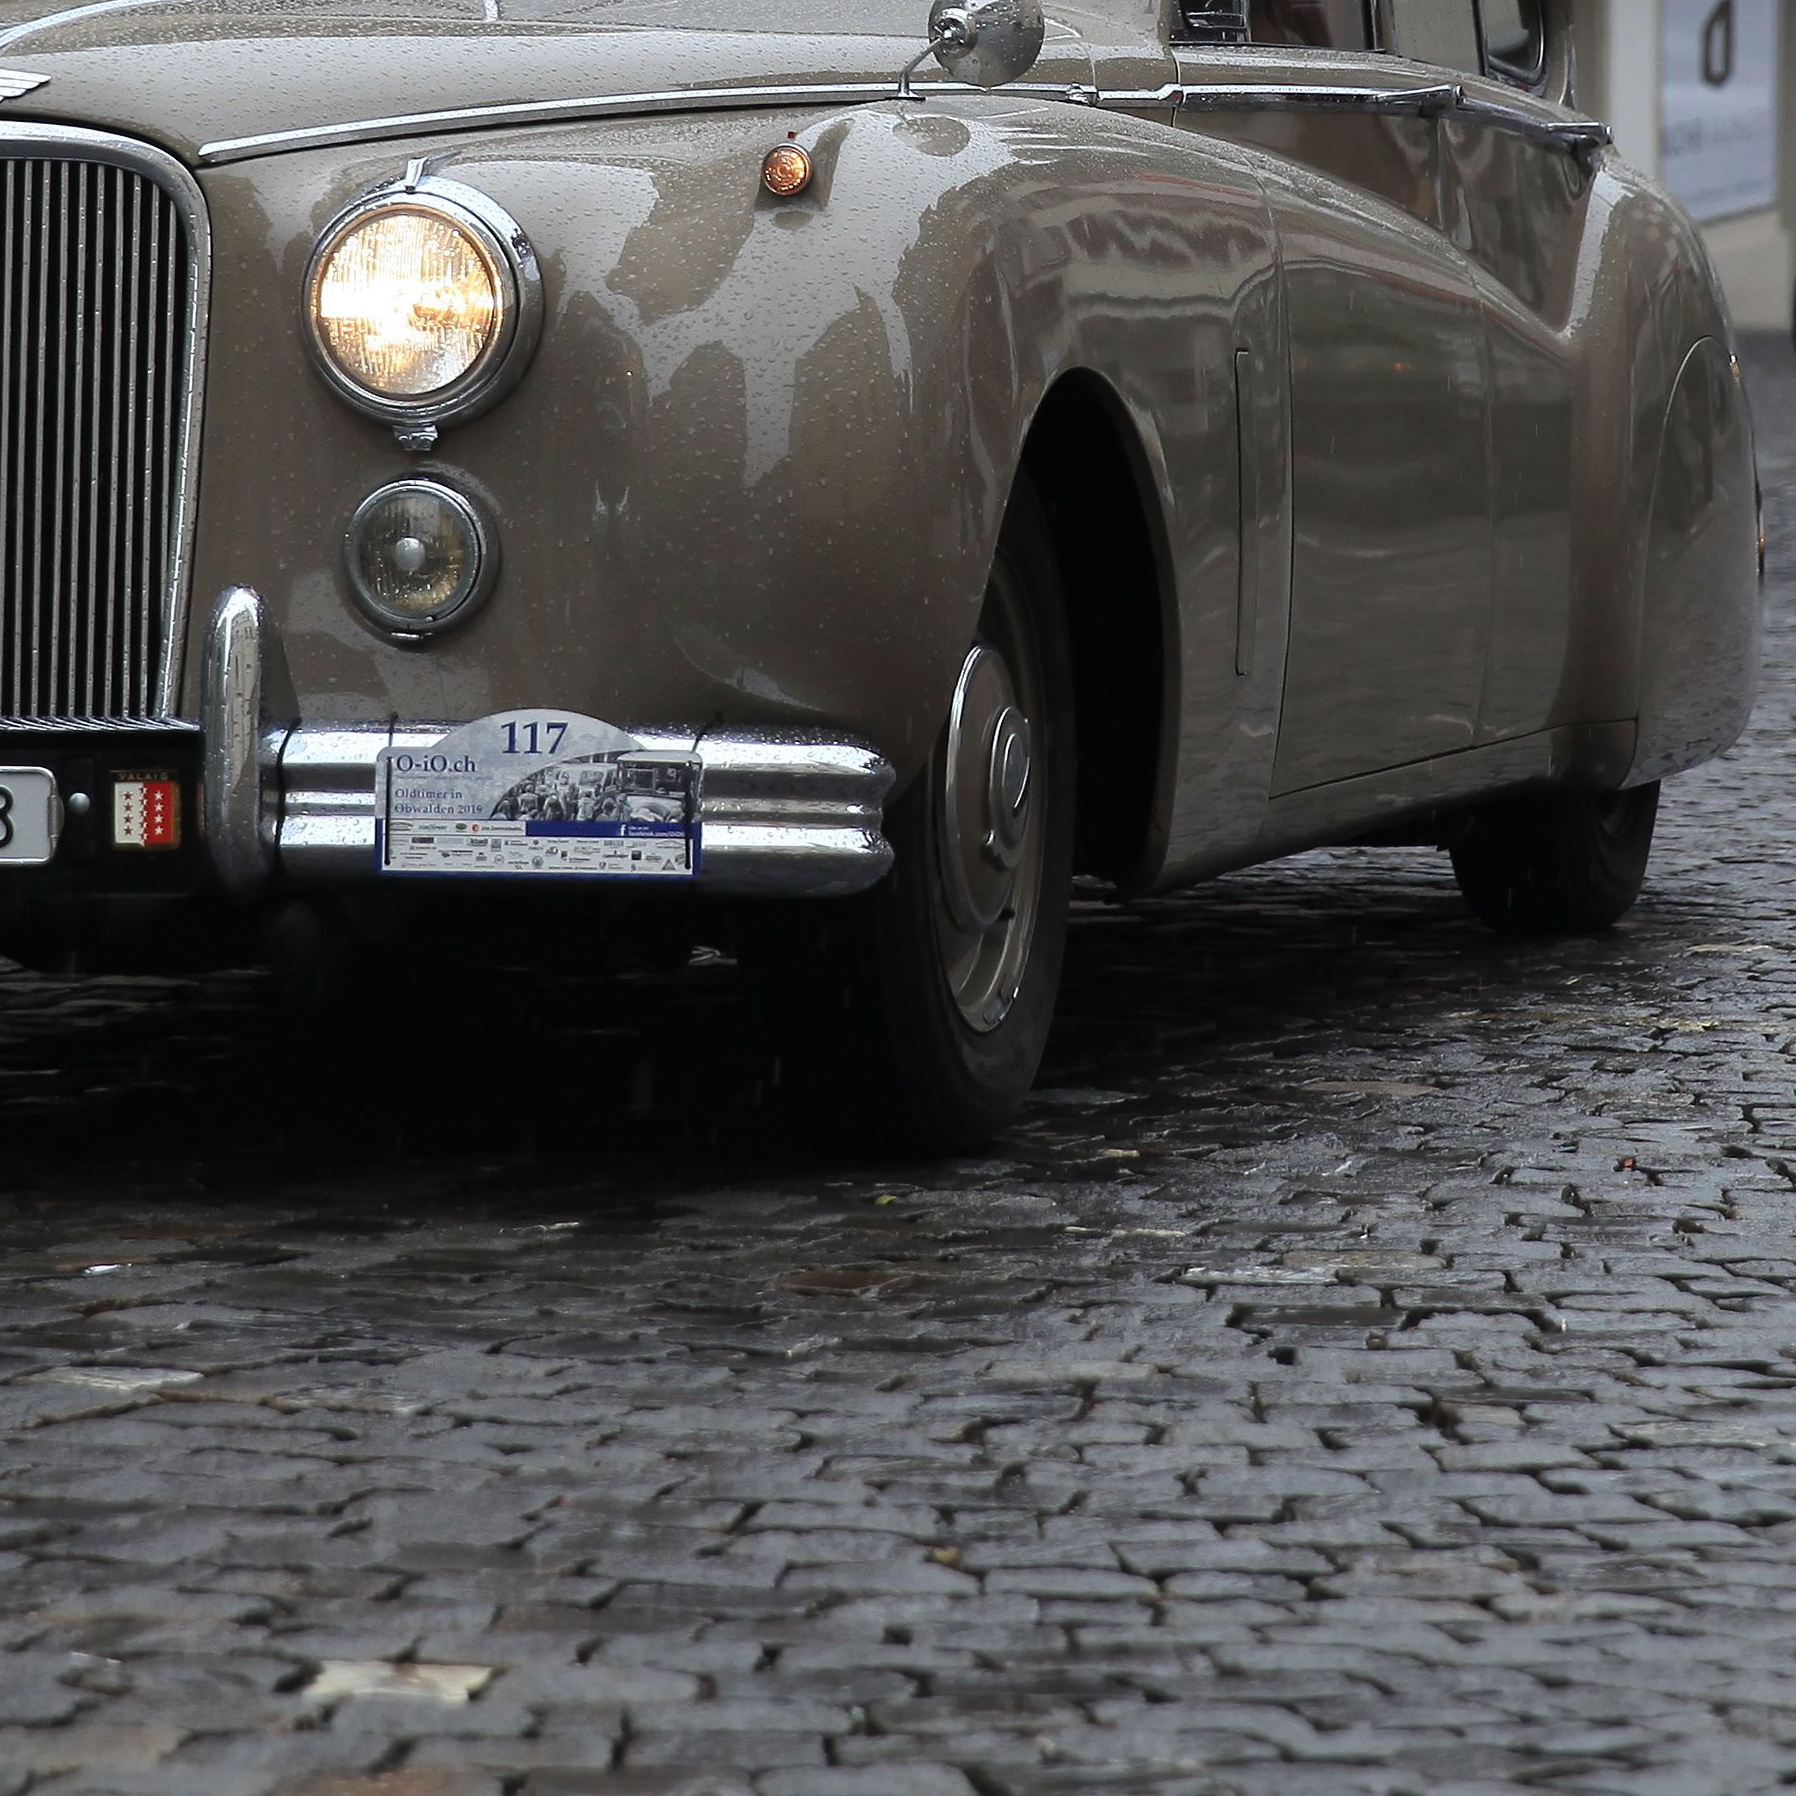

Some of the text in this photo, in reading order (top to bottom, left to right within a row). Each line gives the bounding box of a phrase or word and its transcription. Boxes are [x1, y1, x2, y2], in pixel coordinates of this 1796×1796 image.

[501, 721, 569, 754] 117
[396, 754, 476, 773] O-iO.ch
[118, 772, 169, 781] VALAIS
[394, 788, 463, 799] Oldtimer in
[394, 803, 483, 814] Obwalden 2019
